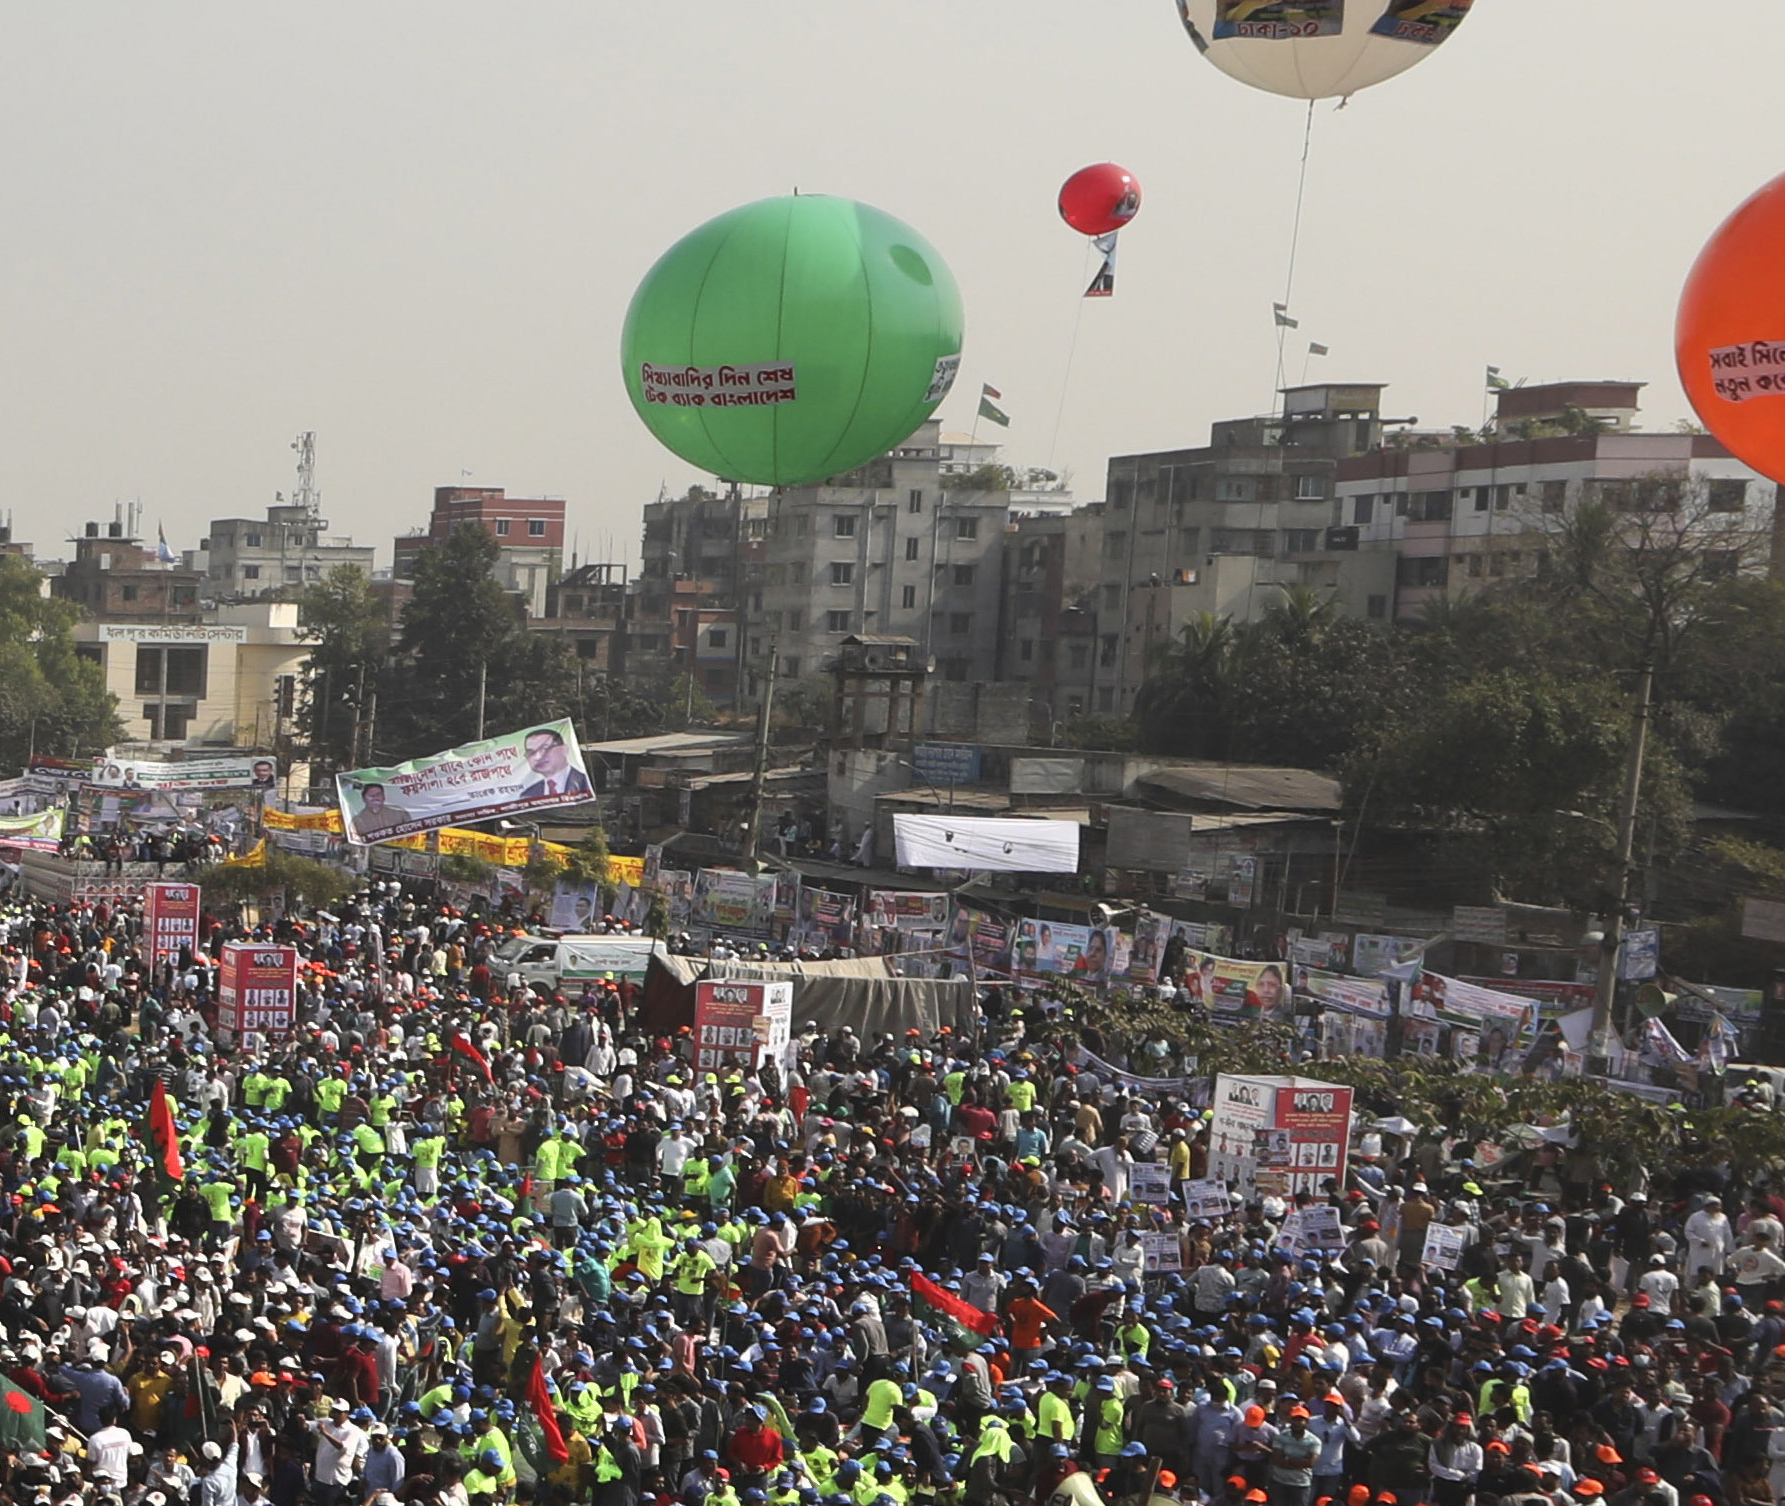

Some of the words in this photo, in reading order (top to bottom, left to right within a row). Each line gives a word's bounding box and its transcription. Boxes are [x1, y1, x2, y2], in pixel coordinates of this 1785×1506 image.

[1238, 21, 1318, 38] ঢাকা-১০
[1709, 346, 1749, 369] সবাই
[642, 363, 713, 390] মিথ্যাবাদির
[719, 366, 750, 387] দিন
[757, 367, 793, 385] শেষ
[645, 385, 668, 404] টেক
[672, 392, 705, 407] ব্যাক
[711, 387, 796, 406] বাংলাদেশ
[1715, 377, 1751, 401] নতুন
[441, 759, 465, 776] যাবে
[467, 753, 493, 768] কোন
[496, 746, 519, 762] পথে
[470, 764, 513, 783] রাজপথে
[467, 788, 496, 800] তারেক
[498, 784, 525, 796] রহমান
[396, 821, 423, 834] হোসেন
[424, 814, 452, 828] সরকার
